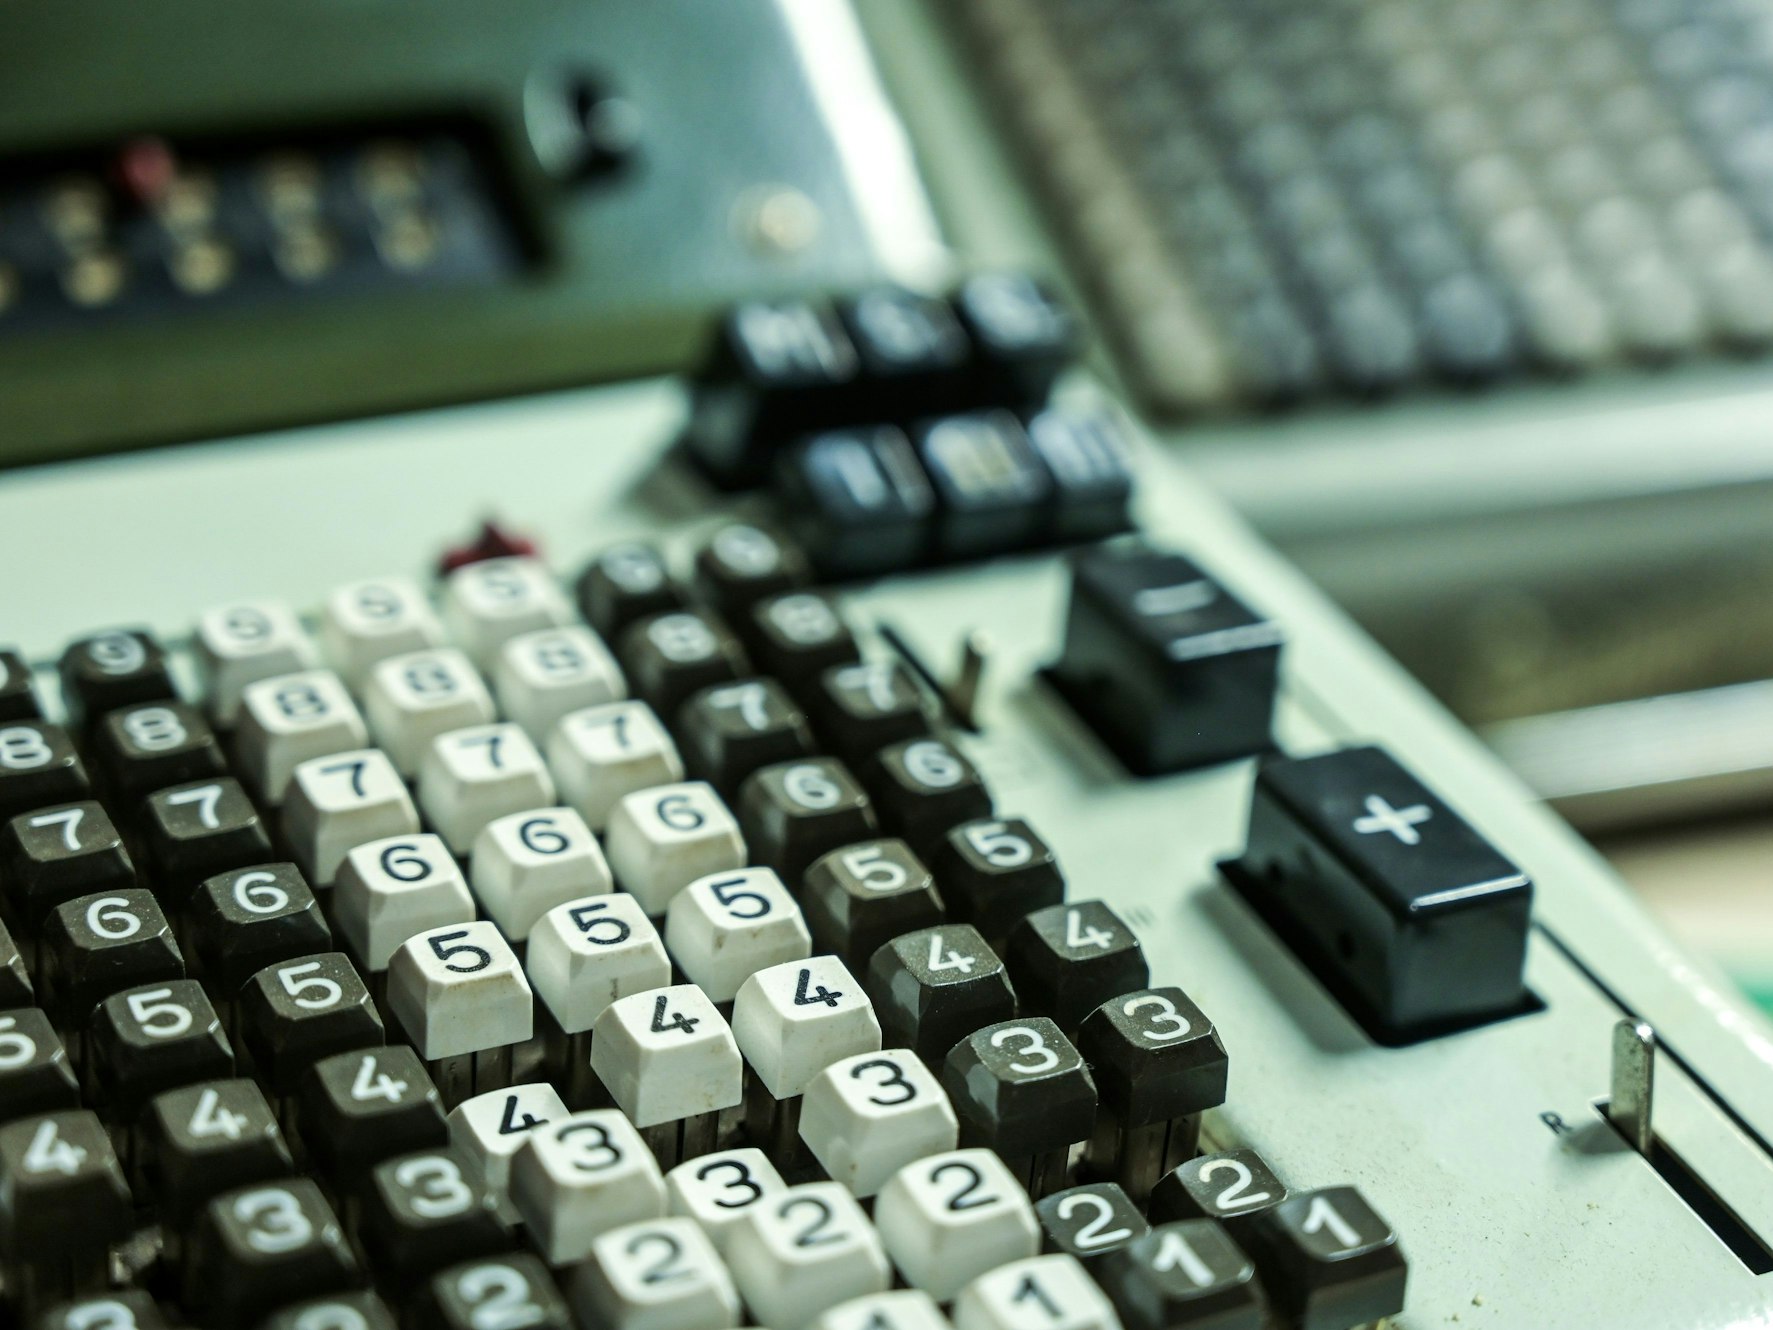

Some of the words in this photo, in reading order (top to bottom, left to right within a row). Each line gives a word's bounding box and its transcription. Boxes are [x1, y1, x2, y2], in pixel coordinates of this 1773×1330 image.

[89, 631, 145, 675] 9
[710, 682, 770, 730] 7
[836, 665, 896, 710] 7
[0, 727, 52, 768] 8
[124, 707, 187, 750] 8
[584, 716, 630, 746] 7
[459, 736, 502, 767] 7
[904, 740, 963, 787] 6
[320, 761, 368, 797] 7
[784, 763, 842, 809] 6
[166, 785, 222, 828] 7
[656, 794, 705, 831] 6
[30, 809, 83, 850] 7
[519, 818, 569, 854] 6
[964, 821, 1032, 866] 5
[380, 845, 432, 882] 6
[842, 847, 907, 892] 5
[234, 871, 289, 914] 6
[710, 878, 771, 919] 5
[87, 897, 141, 939] 6
[568, 903, 631, 945] 5
[1066, 910, 1113, 949] 4
[427, 931, 491, 973] 5
[927, 934, 976, 974] 4
[277, 961, 342, 1009] 5
[794, 968, 843, 1007] 4
[127, 988, 192, 1038] 5
[650, 996, 700, 1034] 4
[1123, 995, 1191, 1040] 3
[991, 1026, 1059, 1074] 3
[351, 1056, 408, 1102] 4
[850, 1060, 917, 1106] 3
[187, 1089, 248, 1139] 4
[499, 1095, 549, 1135] 4
[1539, 1112, 1572, 1134] R
[24, 1119, 87, 1175] 4
[557, 1121, 622, 1172] 3
[395, 1156, 474, 1220] 3
[697, 1160, 763, 1208] 3
[931, 1162, 998, 1209] 2
[1199, 1158, 1269, 1209] 2
[233, 1188, 312, 1253] 3
[778, 1198, 847, 1247] 2
[1057, 1193, 1132, 1248] 2
[1305, 1197, 1361, 1247] 1
[626, 1231, 696, 1284] 2
[1154, 1233, 1215, 1287] 1
[458, 1265, 544, 1330] 2
[1015, 1273, 1060, 1317] 1
